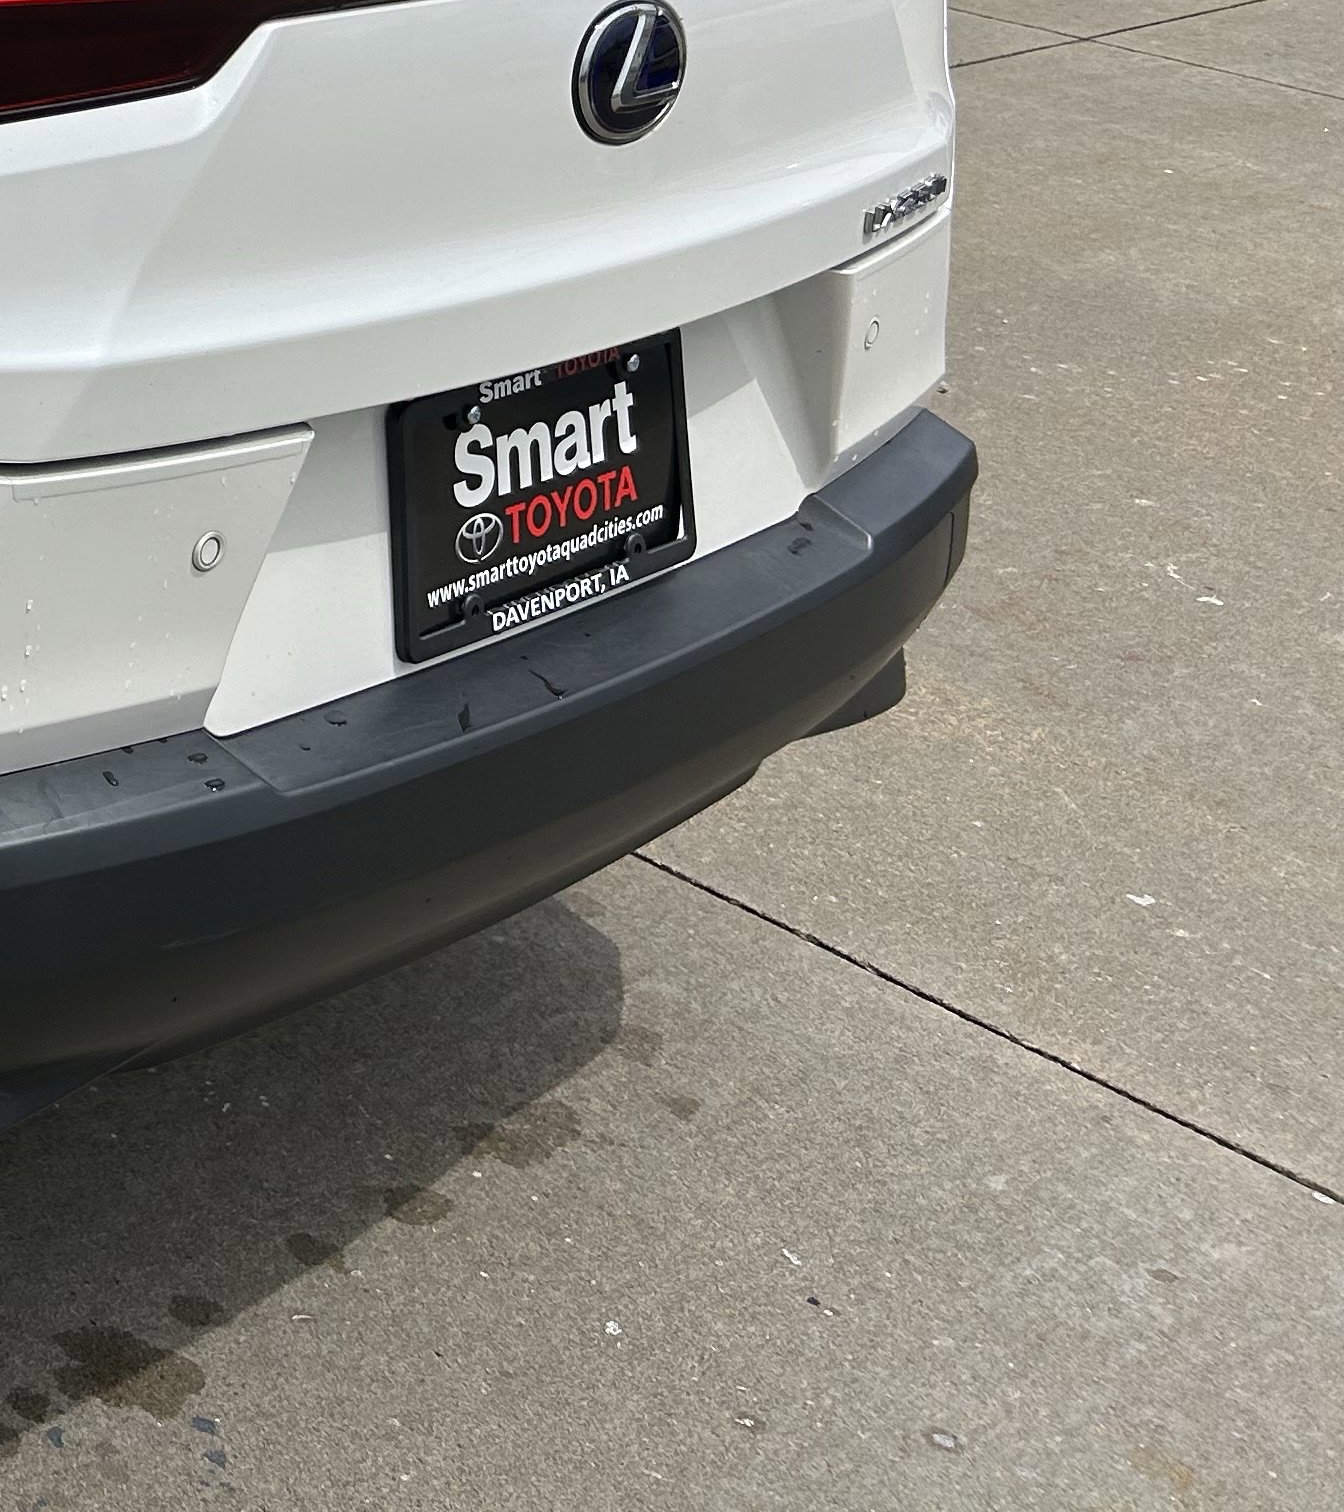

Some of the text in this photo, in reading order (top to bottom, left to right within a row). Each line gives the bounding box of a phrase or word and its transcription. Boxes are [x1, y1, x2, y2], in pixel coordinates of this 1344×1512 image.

[478, 347, 620, 403] Smart TOYOTA
[453, 381, 637, 508] Smart
[505, 465, 638, 544] TOYOTA
[427, 503, 664, 609] www.smarttoyotaquadcities.com
[492, 564, 630, 632] DAVENPORT, IA
